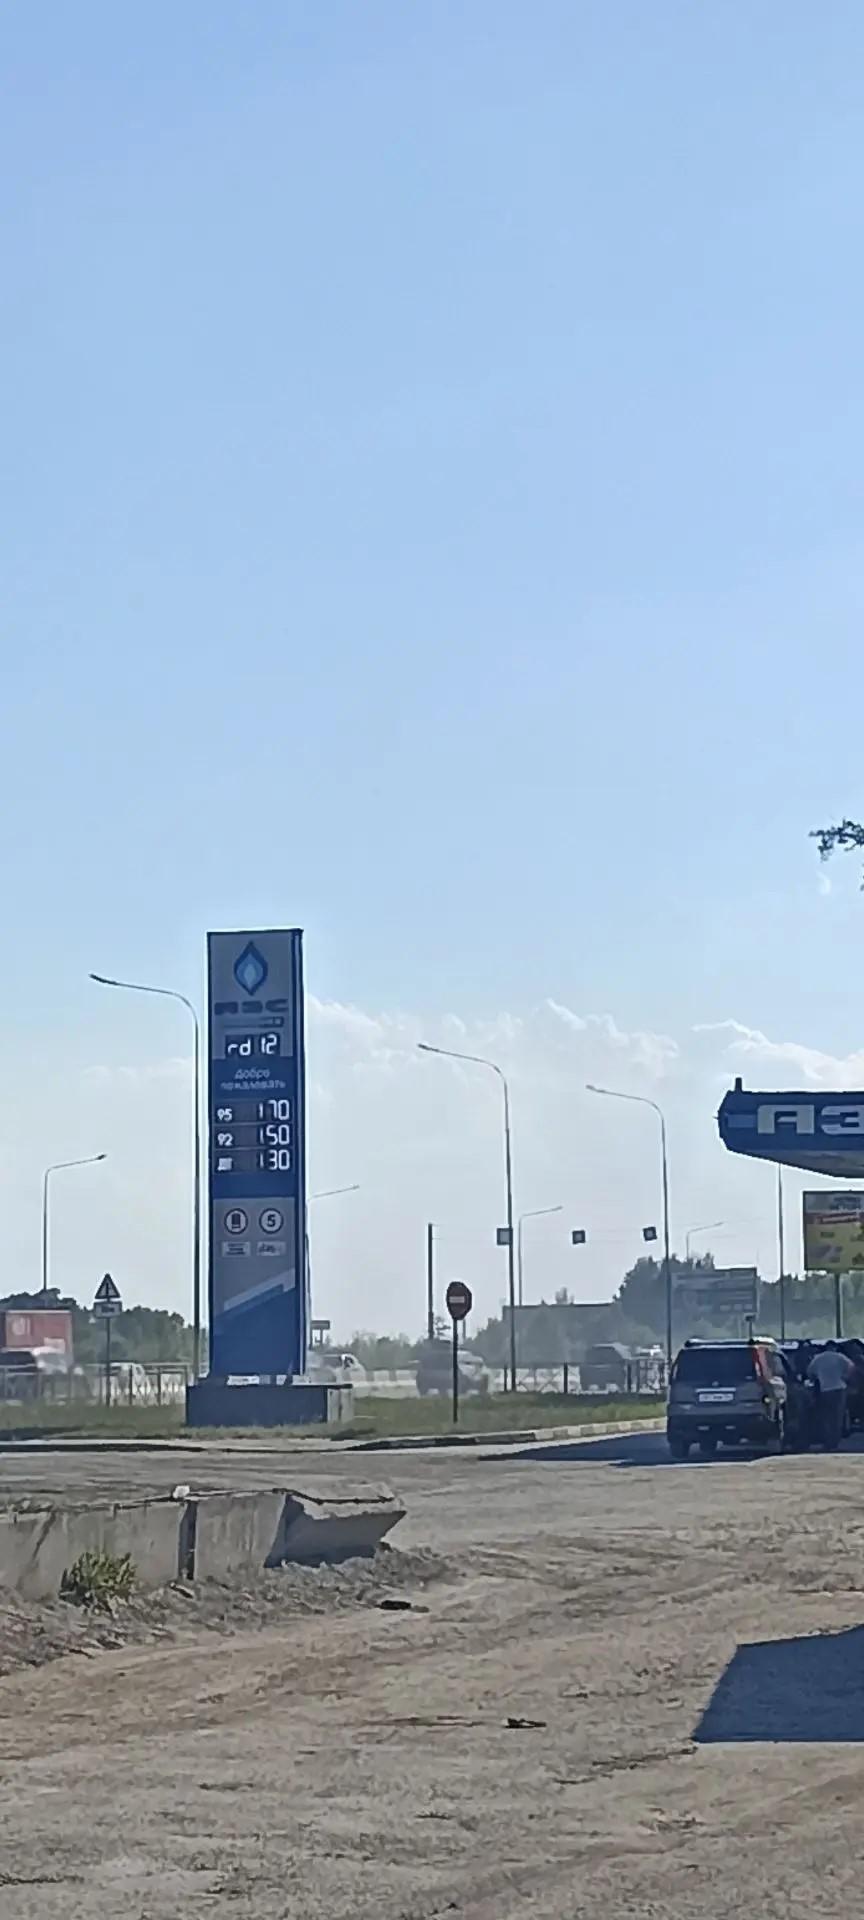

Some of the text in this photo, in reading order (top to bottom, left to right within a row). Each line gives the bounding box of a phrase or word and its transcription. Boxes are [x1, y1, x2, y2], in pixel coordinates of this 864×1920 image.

[261, 1033, 278, 1055] 12
[235, 1067, 271, 1080] Добро
[217, 1099, 290, 1121] 95 170
[217, 1124, 290, 1146] 92 150
[259, 1149, 290, 1170] 130
[267, 1214, 276, 1227] 5
